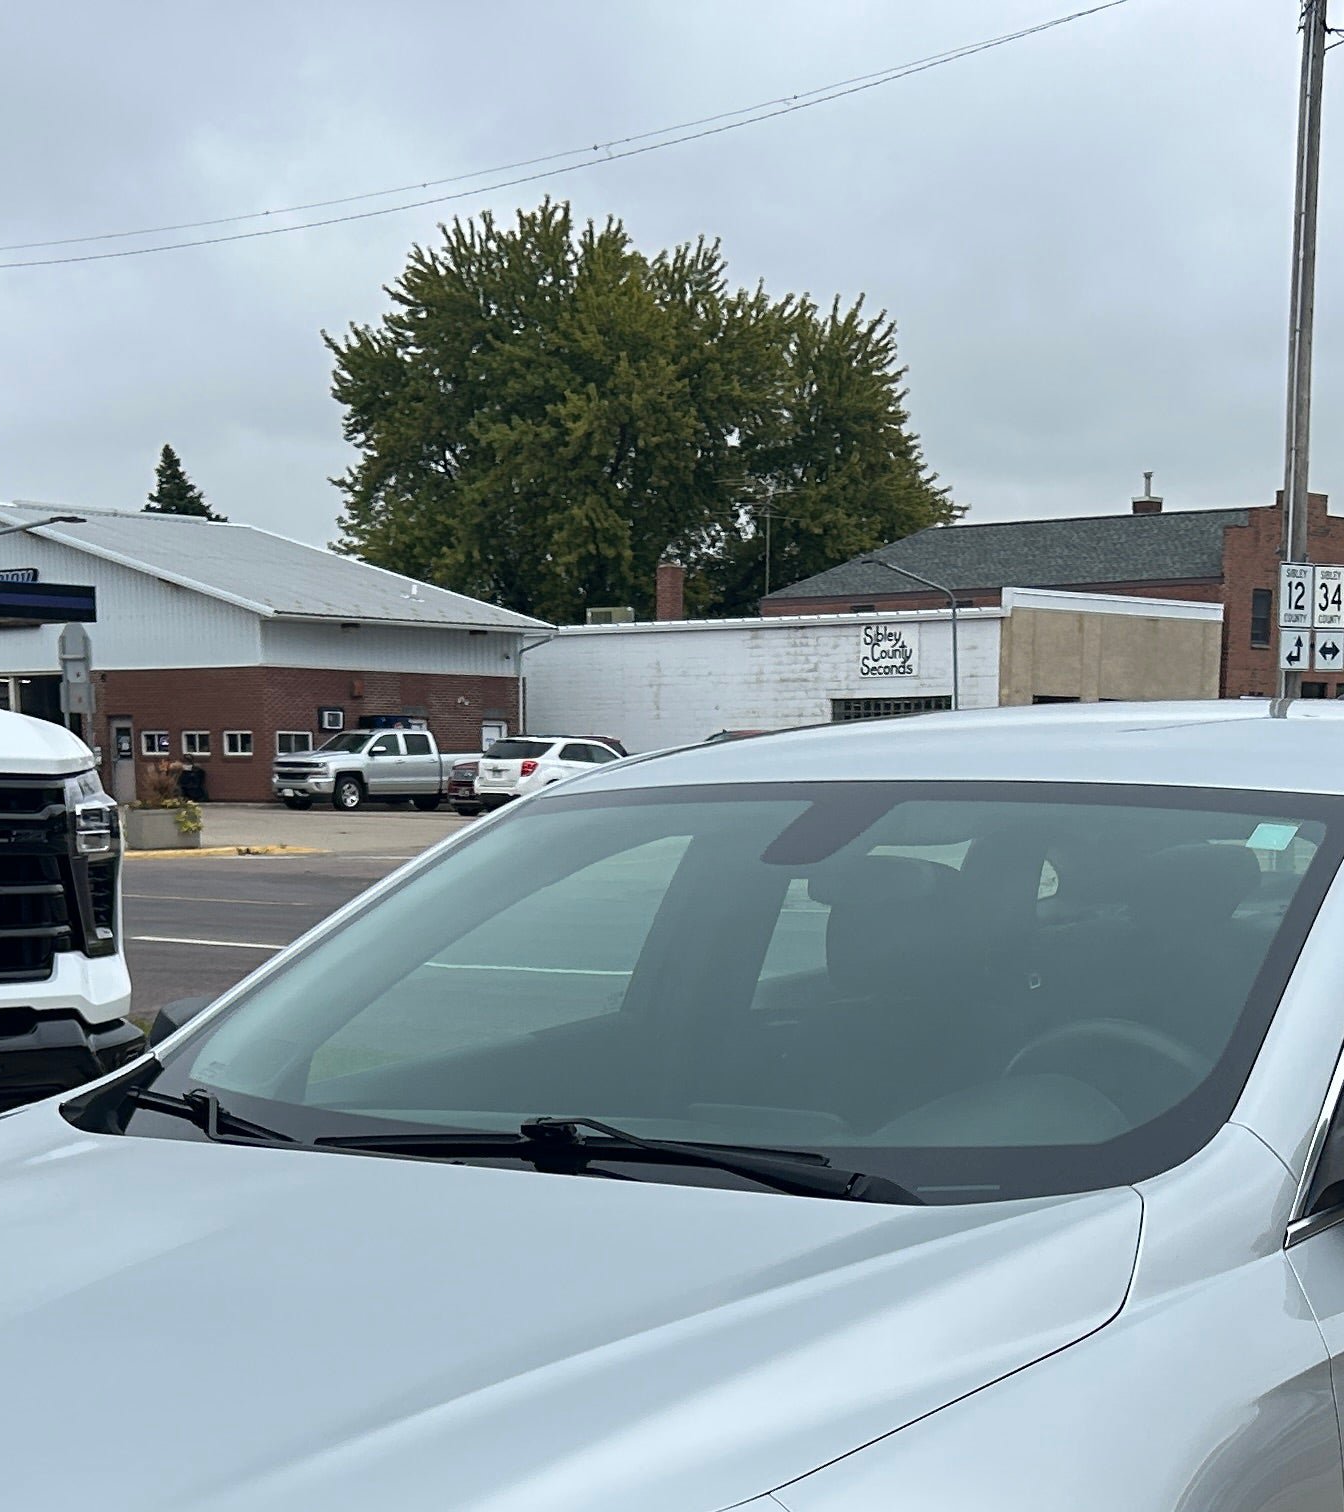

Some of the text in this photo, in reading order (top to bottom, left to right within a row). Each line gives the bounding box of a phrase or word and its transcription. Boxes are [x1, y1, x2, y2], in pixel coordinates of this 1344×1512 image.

[1286, 568, 1308, 579] SIBLEY
[1320, 570, 1342, 580] SIBLEY
[1287, 580, 1305, 610] 12
[1318, 582, 1342, 611] 34
[1283, 612, 1307, 623] COUNTY
[1318, 614, 1342, 624] COUNTY
[863, 625, 902, 649] Sibley
[870, 640, 913, 664] County
[860, 655, 913, 676] Seconds
